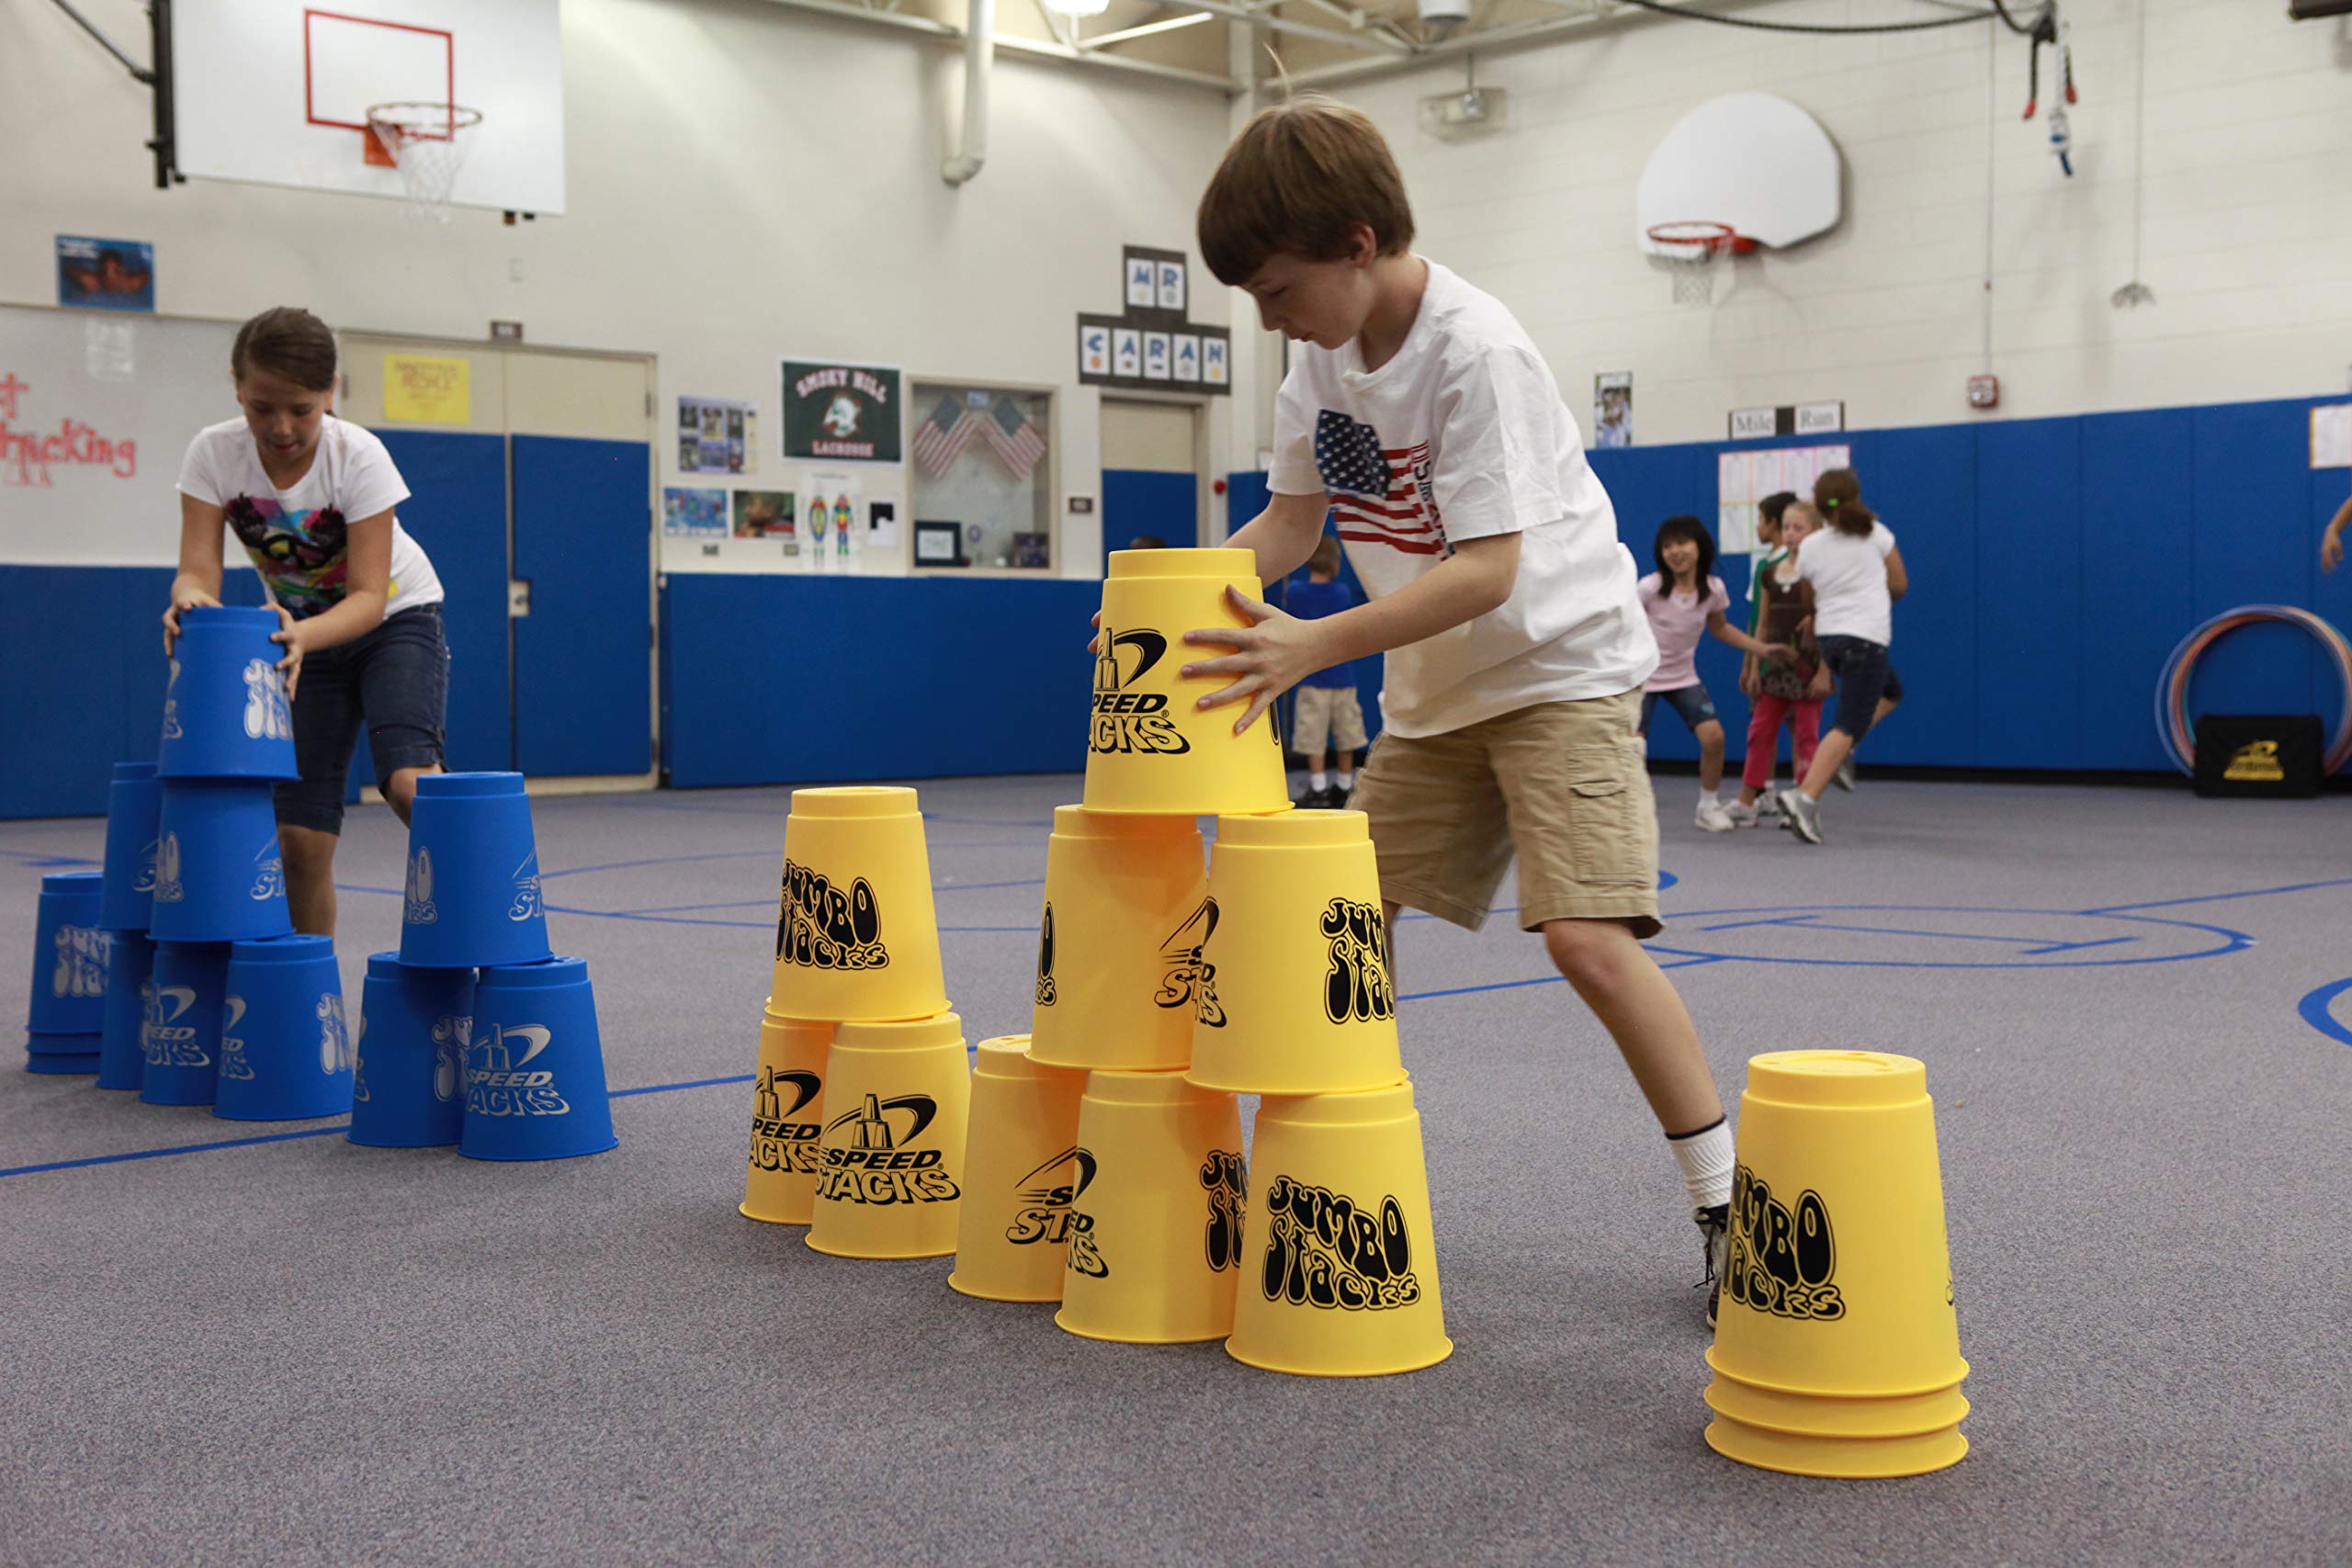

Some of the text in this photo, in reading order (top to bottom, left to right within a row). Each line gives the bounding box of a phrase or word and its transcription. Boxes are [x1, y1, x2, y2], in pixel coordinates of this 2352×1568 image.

[1134, 266, 1178, 289] MR
[1088, 334, 1223, 363] CARAN
[1736, 408, 1834, 432] Mile Run
[1091, 694, 1168, 714] PEED
[752, 1118, 821, 1140] PEED
[825, 1149, 942, 1170] SPEED
[815, 1163, 961, 1205] STACKS
[1267, 1175, 1412, 1284] JUMBO
